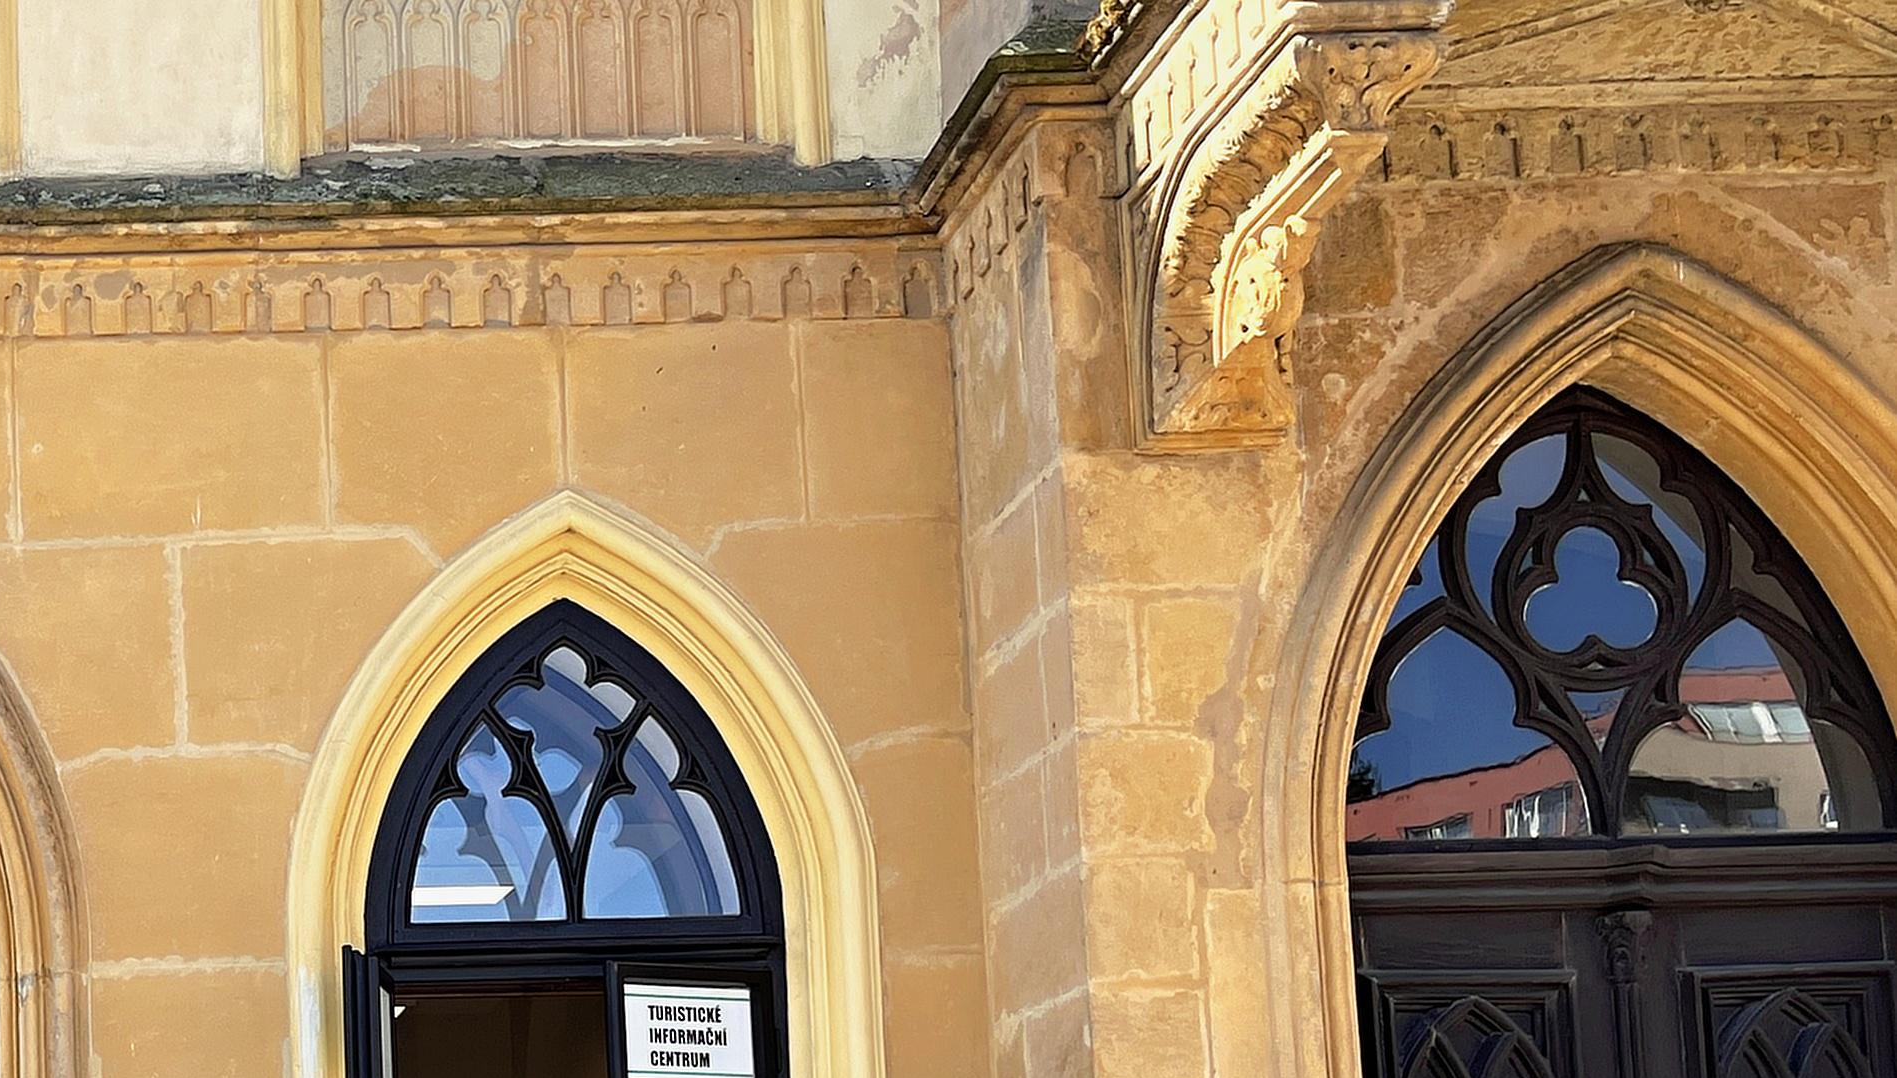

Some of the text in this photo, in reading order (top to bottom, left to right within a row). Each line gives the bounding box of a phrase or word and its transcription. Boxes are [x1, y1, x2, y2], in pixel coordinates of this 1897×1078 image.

[647, 1005, 722, 1023] TURISTICKÉ
[649, 1027, 728, 1046] INFORMAČNÍ
[650, 1051, 711, 1068] CENTRUM
